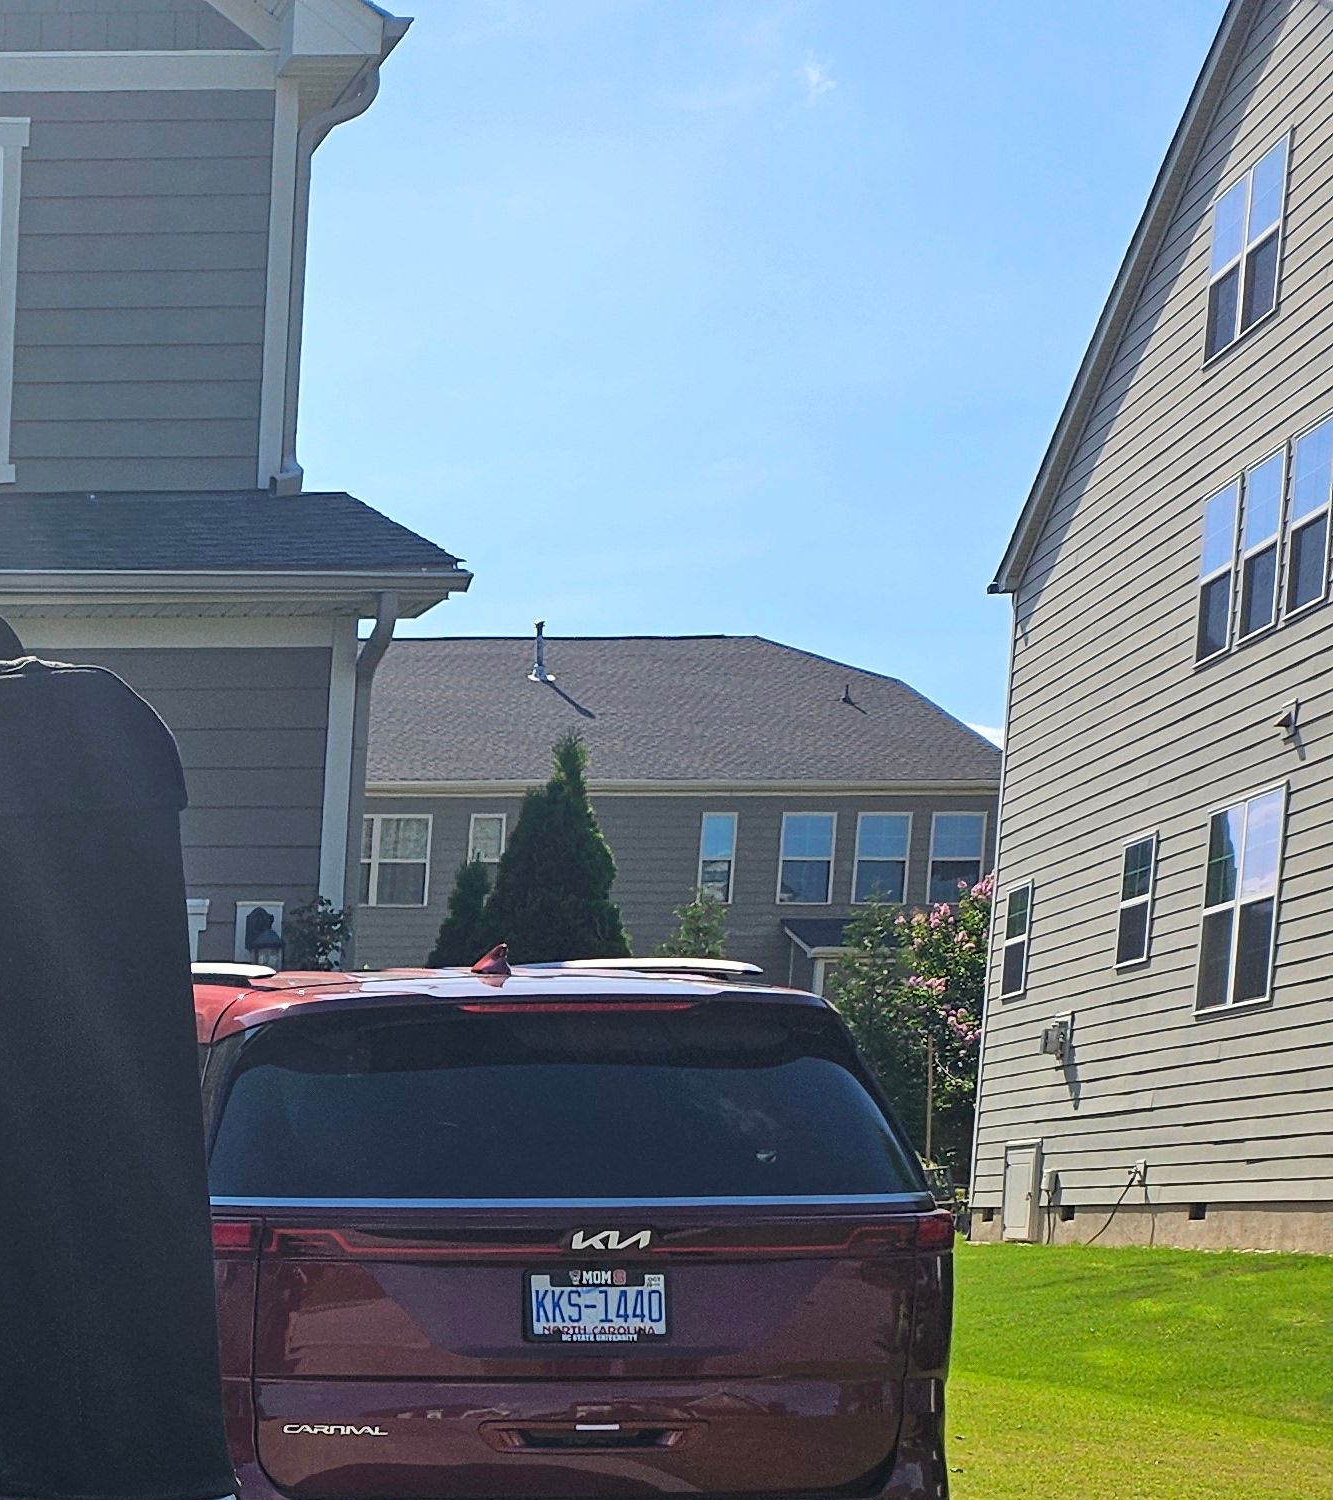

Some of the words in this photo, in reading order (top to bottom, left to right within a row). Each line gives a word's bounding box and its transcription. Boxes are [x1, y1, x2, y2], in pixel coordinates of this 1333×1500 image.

[571, 1230, 651, 1249] KIA
[582, 1270, 612, 1285] MOM
[536, 1289, 662, 1323] KKS-1440
[542, 1325, 587, 1334] NORTH
[592, 1325, 655, 1334] CAROLINA
